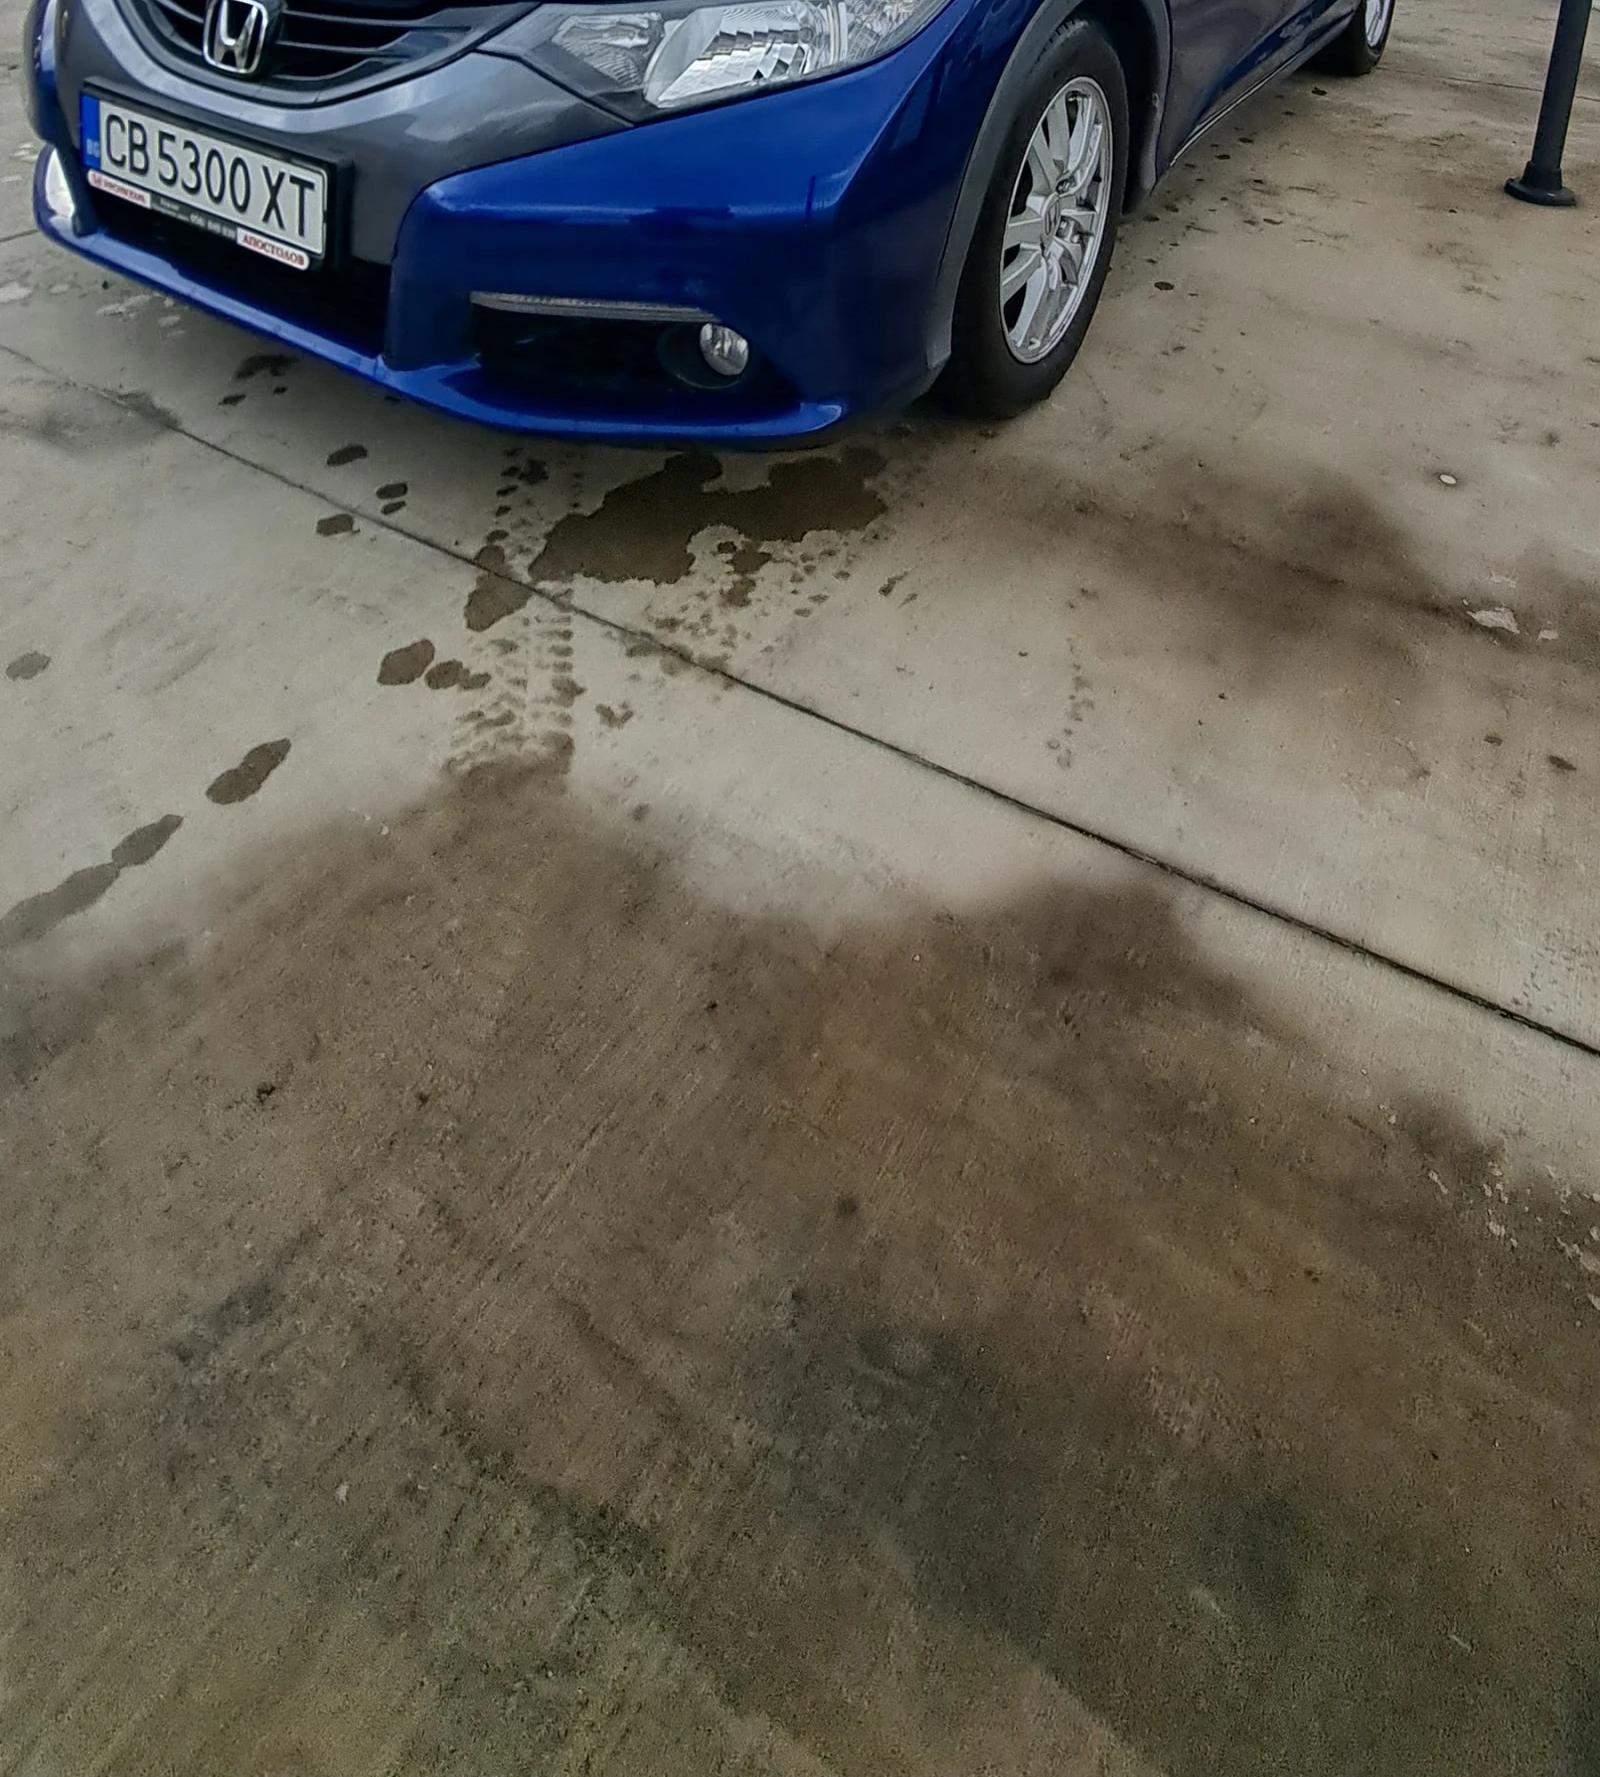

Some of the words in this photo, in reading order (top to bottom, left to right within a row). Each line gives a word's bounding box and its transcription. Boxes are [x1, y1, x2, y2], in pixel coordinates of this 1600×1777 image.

[106, 113, 150, 177] CB
[157, 130, 251, 215] 5300
[262, 165, 316, 238] XT
[243, 234, 305, 266] АПОСТОЛОВ
